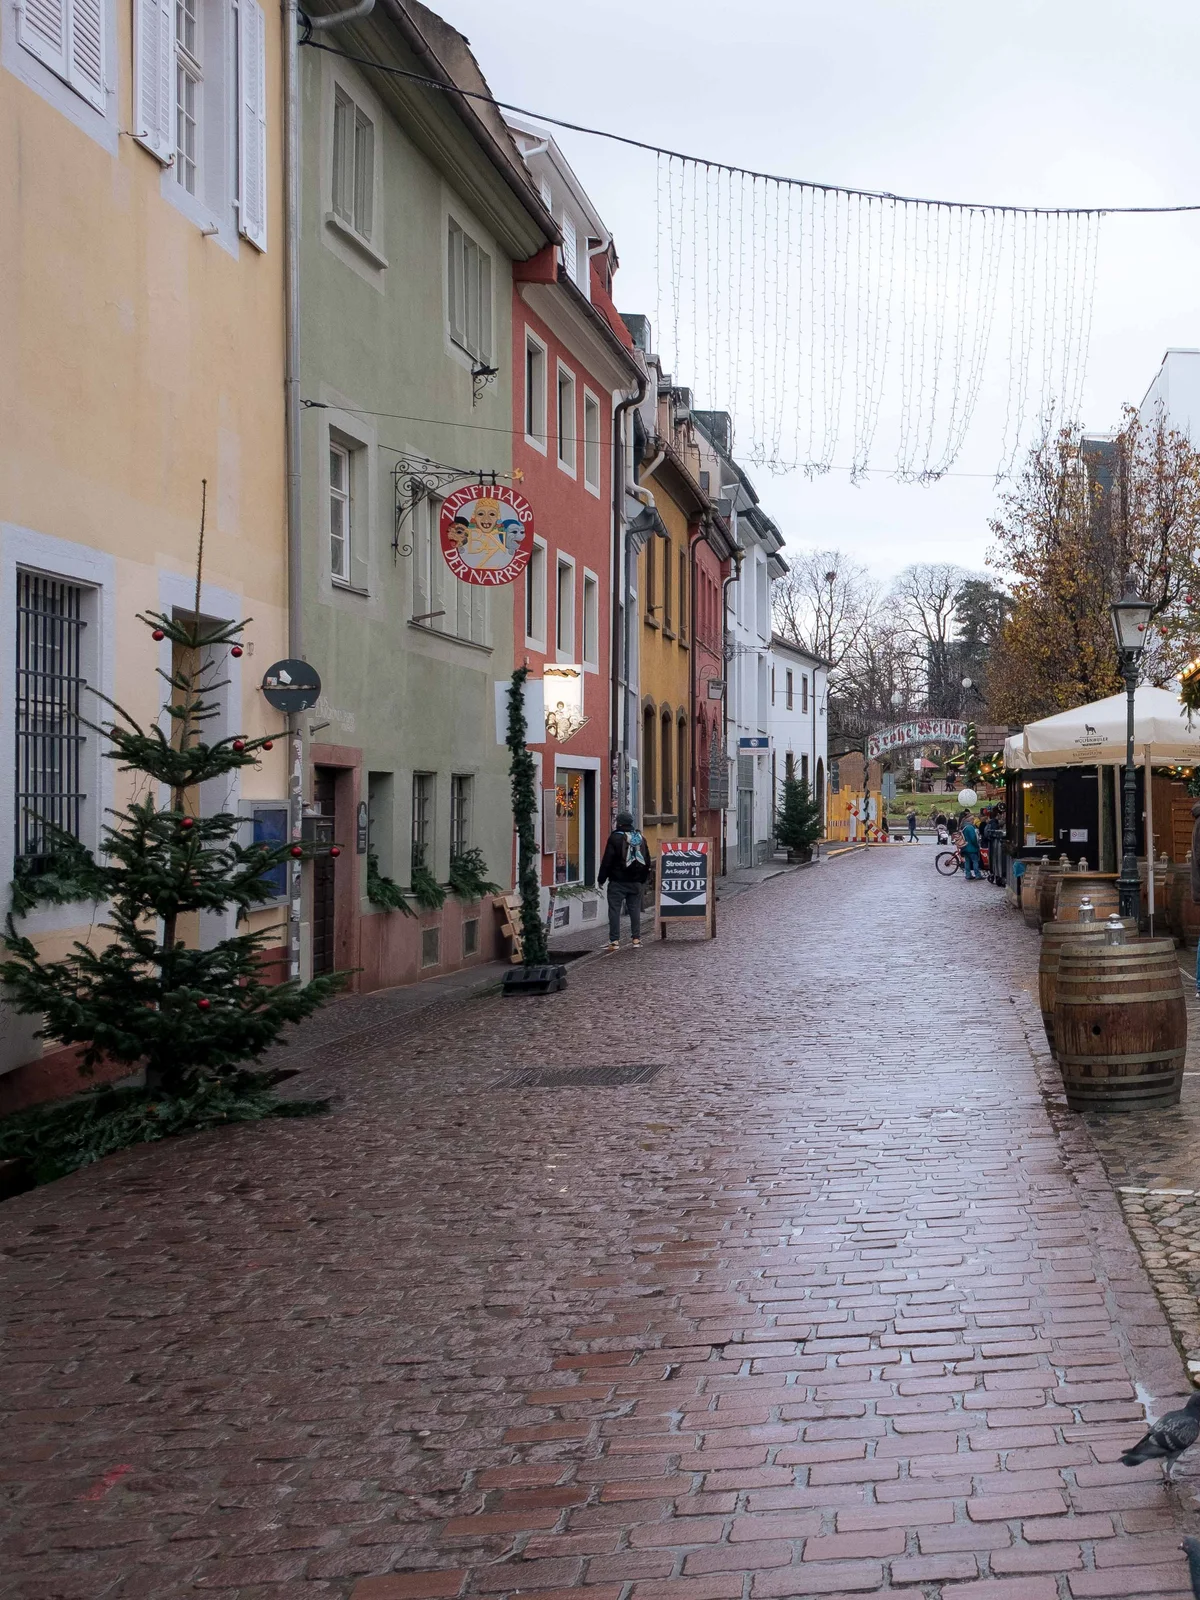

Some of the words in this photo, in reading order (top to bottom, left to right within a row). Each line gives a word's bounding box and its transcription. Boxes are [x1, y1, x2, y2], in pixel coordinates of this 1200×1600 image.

[441, 485, 533, 522] ZUNFTHAUS
[444, 548, 469, 578] DER
[469, 549, 530, 585] NARREN
[869, 727, 912, 756] Frohe
[918, 720, 967, 738] Weihna
[661, 879, 705, 891] SHOP
